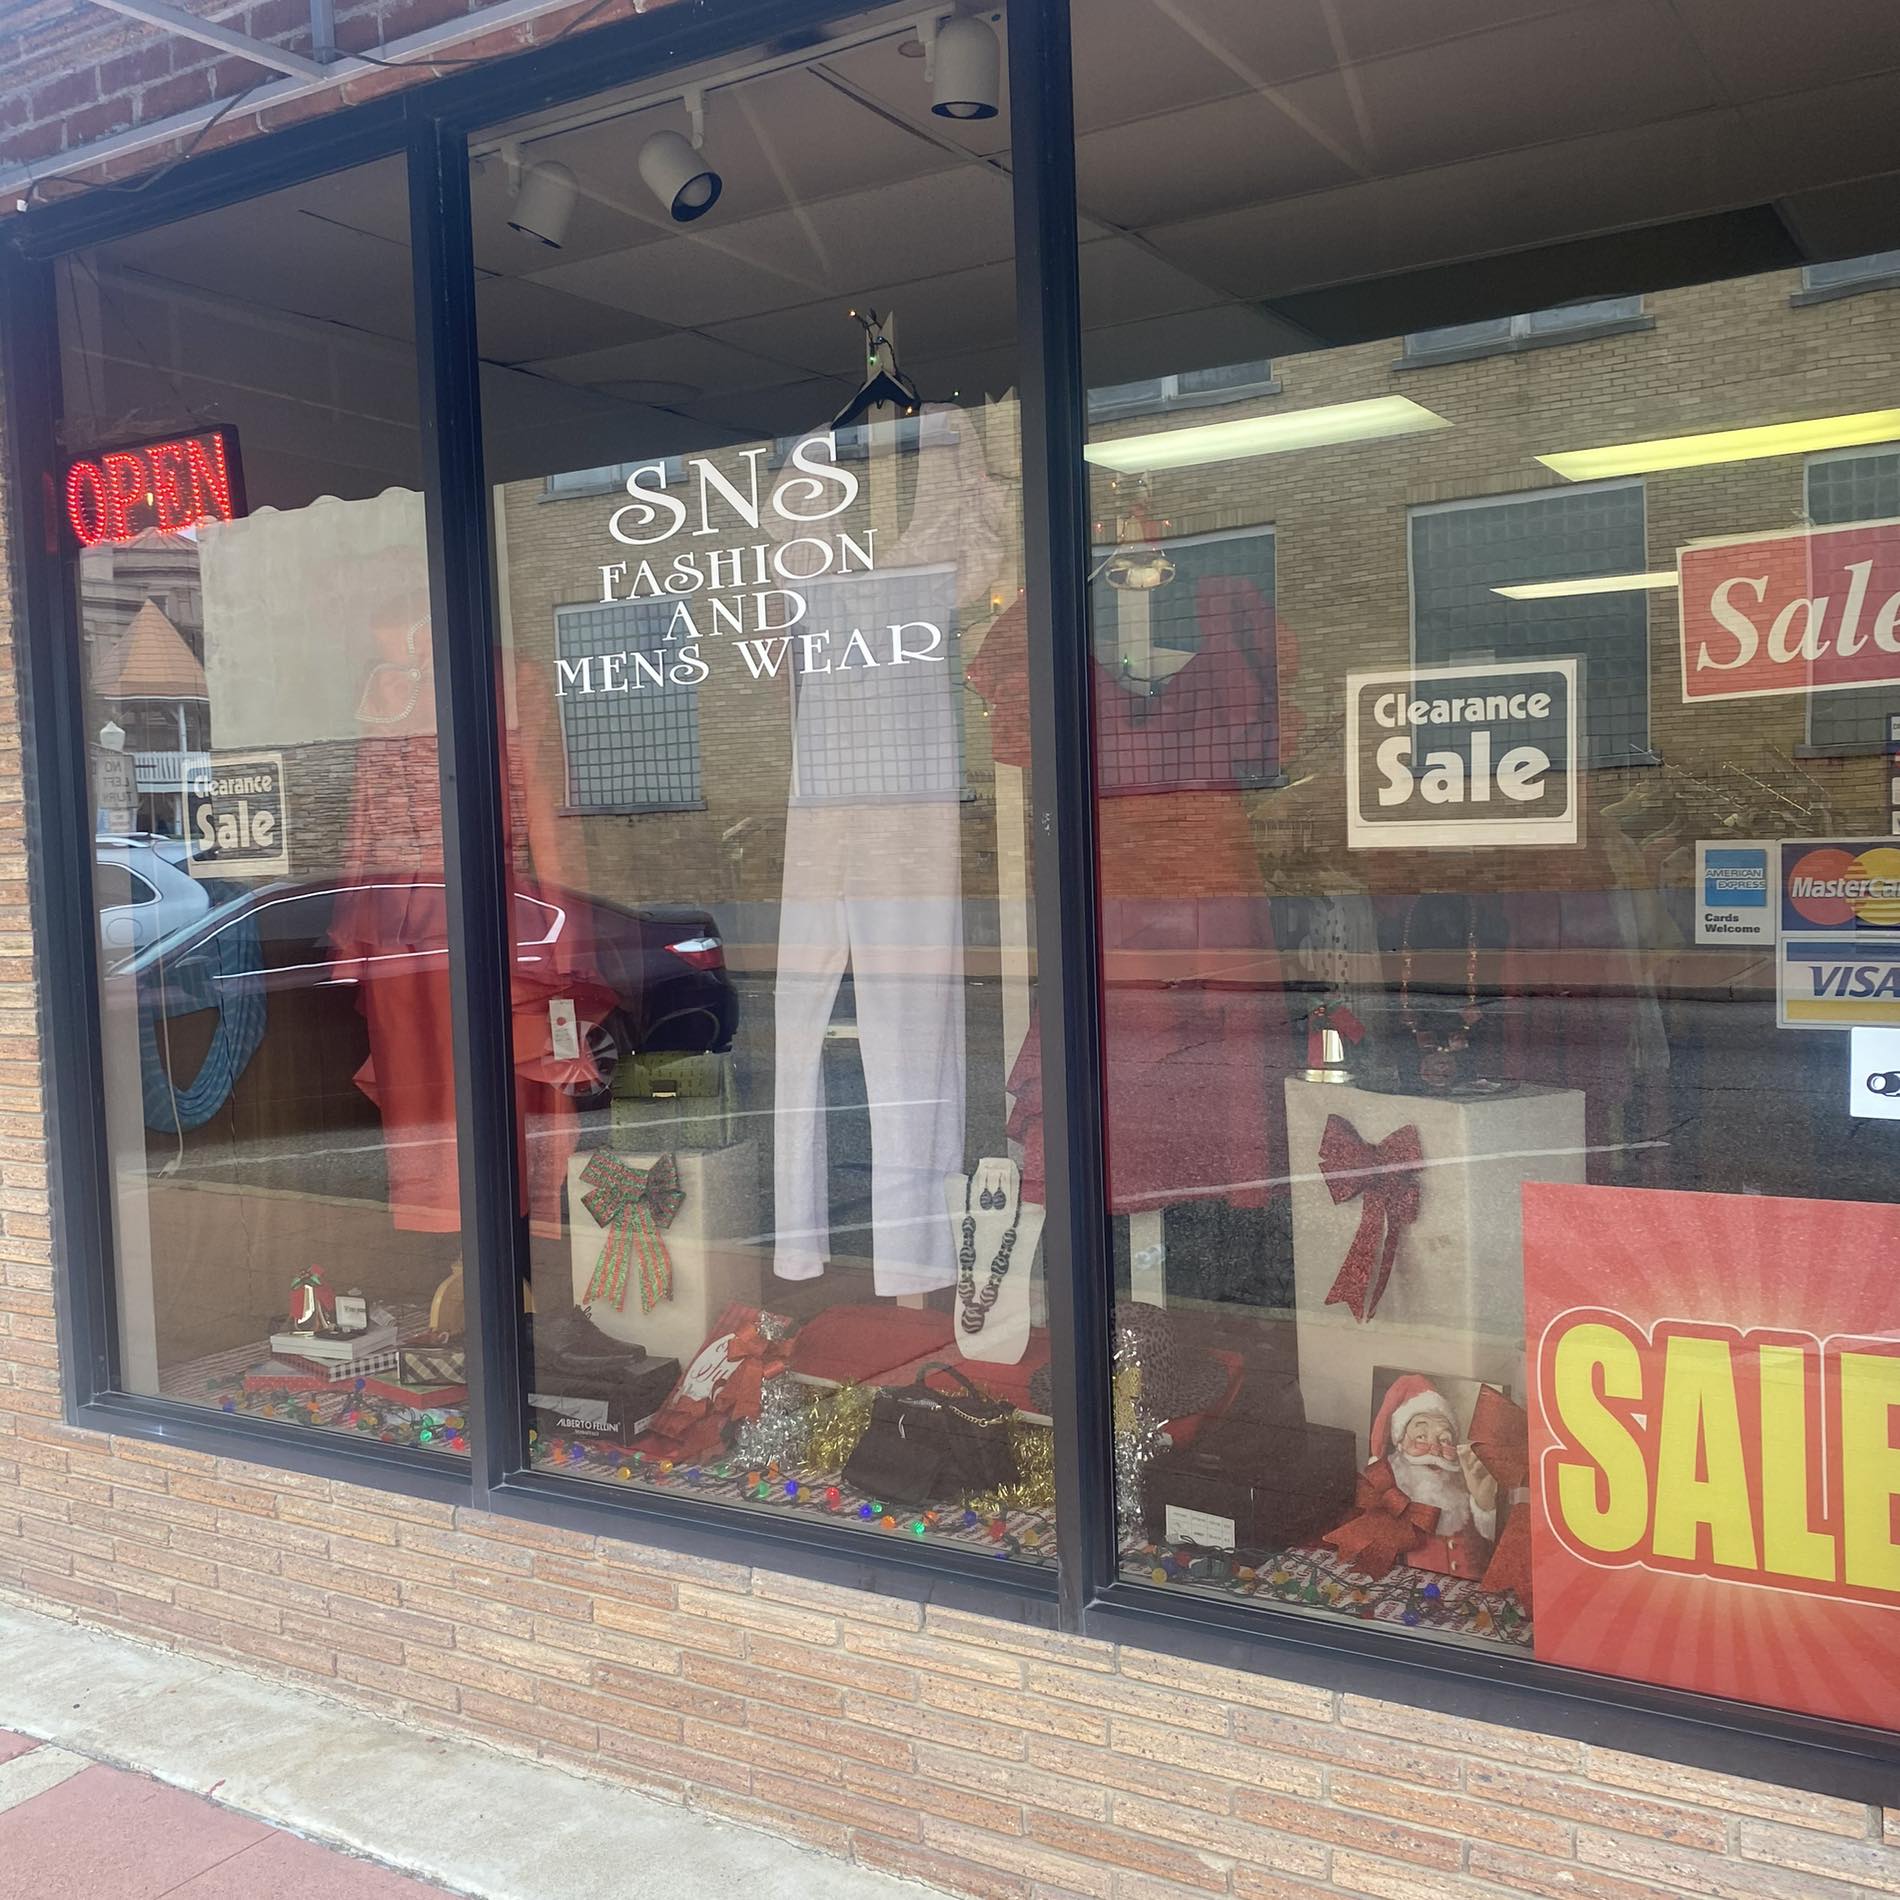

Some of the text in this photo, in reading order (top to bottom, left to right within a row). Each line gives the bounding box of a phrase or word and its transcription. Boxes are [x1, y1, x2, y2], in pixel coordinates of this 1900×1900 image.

[66, 431, 234, 547] OPEN
[608, 431, 860, 545] SNS
[598, 528, 879, 604] FASHION
[662, 588, 807, 641] AND
[555, 621, 945, 696] MENS WEAR
[1374, 692, 1551, 728] Clearance
[193, 774, 273, 798] Clearance
[1376, 731, 1551, 807] Sale
[196, 800, 276, 851] Sale
[1705, 869, 1762, 878] AMERICAN
[1717, 880, 1766, 890] EXPRESS
[1704, 913, 1740, 923] Cards
[1704, 924, 1761, 934] Welcome
[1808, 965, 1900, 998] VISA
[556, 1418, 592, 1430] ALBERTO
[592, 1422, 619, 1433] FELLINI
[1555, 1323, 1900, 1593] SALE
